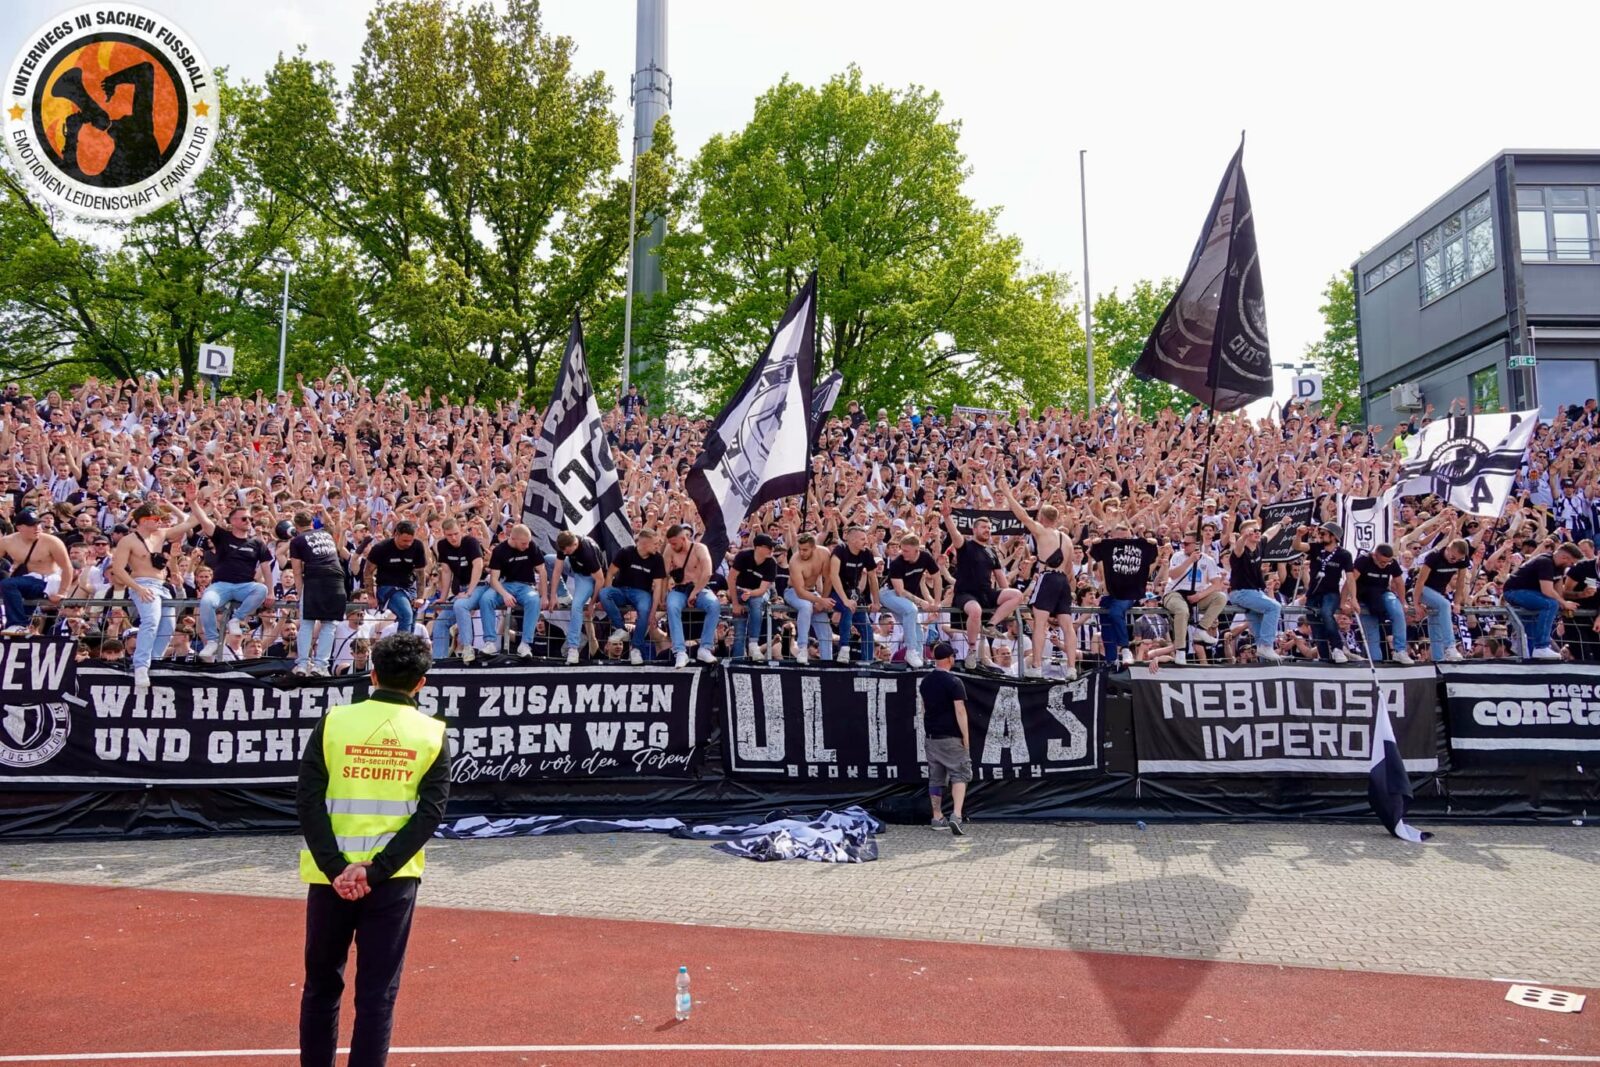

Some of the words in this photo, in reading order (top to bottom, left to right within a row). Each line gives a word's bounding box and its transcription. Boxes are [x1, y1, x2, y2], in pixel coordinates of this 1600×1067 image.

[206, 349, 226, 370] D
[1298, 380, 1316, 398] D
[0, 642, 74, 690] EW
[90, 685, 177, 719] WIR
[192, 686, 354, 721] HALTEN
[478, 683, 674, 717] ZUSAMMEN
[1160, 681, 1405, 720] NEBULOSA
[732, 673, 1089, 765] ULTAS
[94, 728, 191, 762] UND
[585, 722, 670, 751] WEG
[363, 747, 393, 758] Auftrag
[394, 750, 409, 758] von
[1201, 723, 1371, 760] IMPERO
[342, 766, 414, 782] SECURITY
[450, 752, 532, 783] Brüder
[539, 754, 577, 774] vor
[581, 751, 620, 775] den
[920, 764, 1043, 780] SIETY
